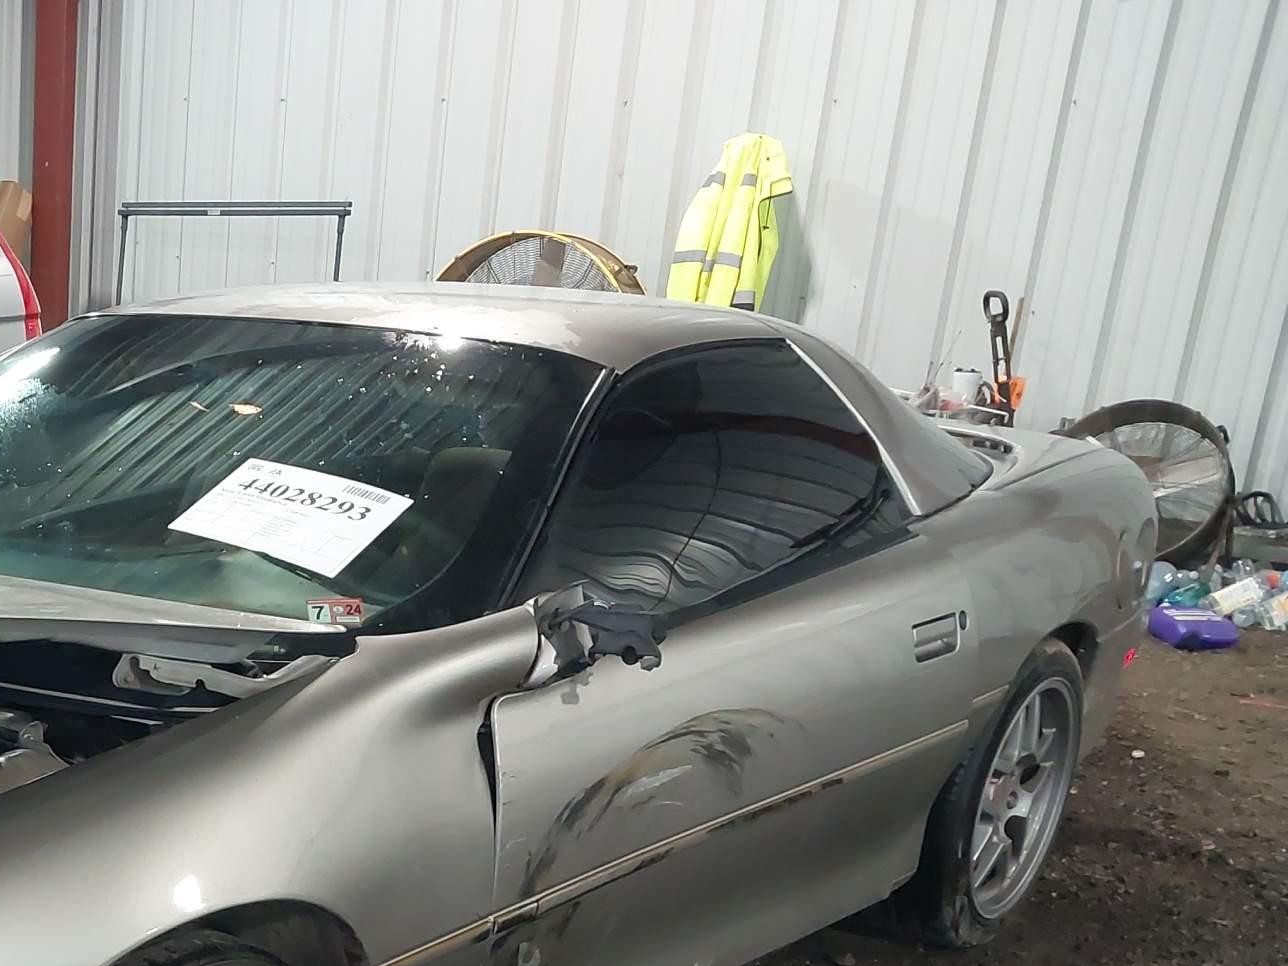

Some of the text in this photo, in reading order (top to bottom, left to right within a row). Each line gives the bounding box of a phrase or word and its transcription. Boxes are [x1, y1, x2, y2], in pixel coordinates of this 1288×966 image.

[237, 477, 372, 521] 44028293
[312, 604, 362, 620] 7 24
